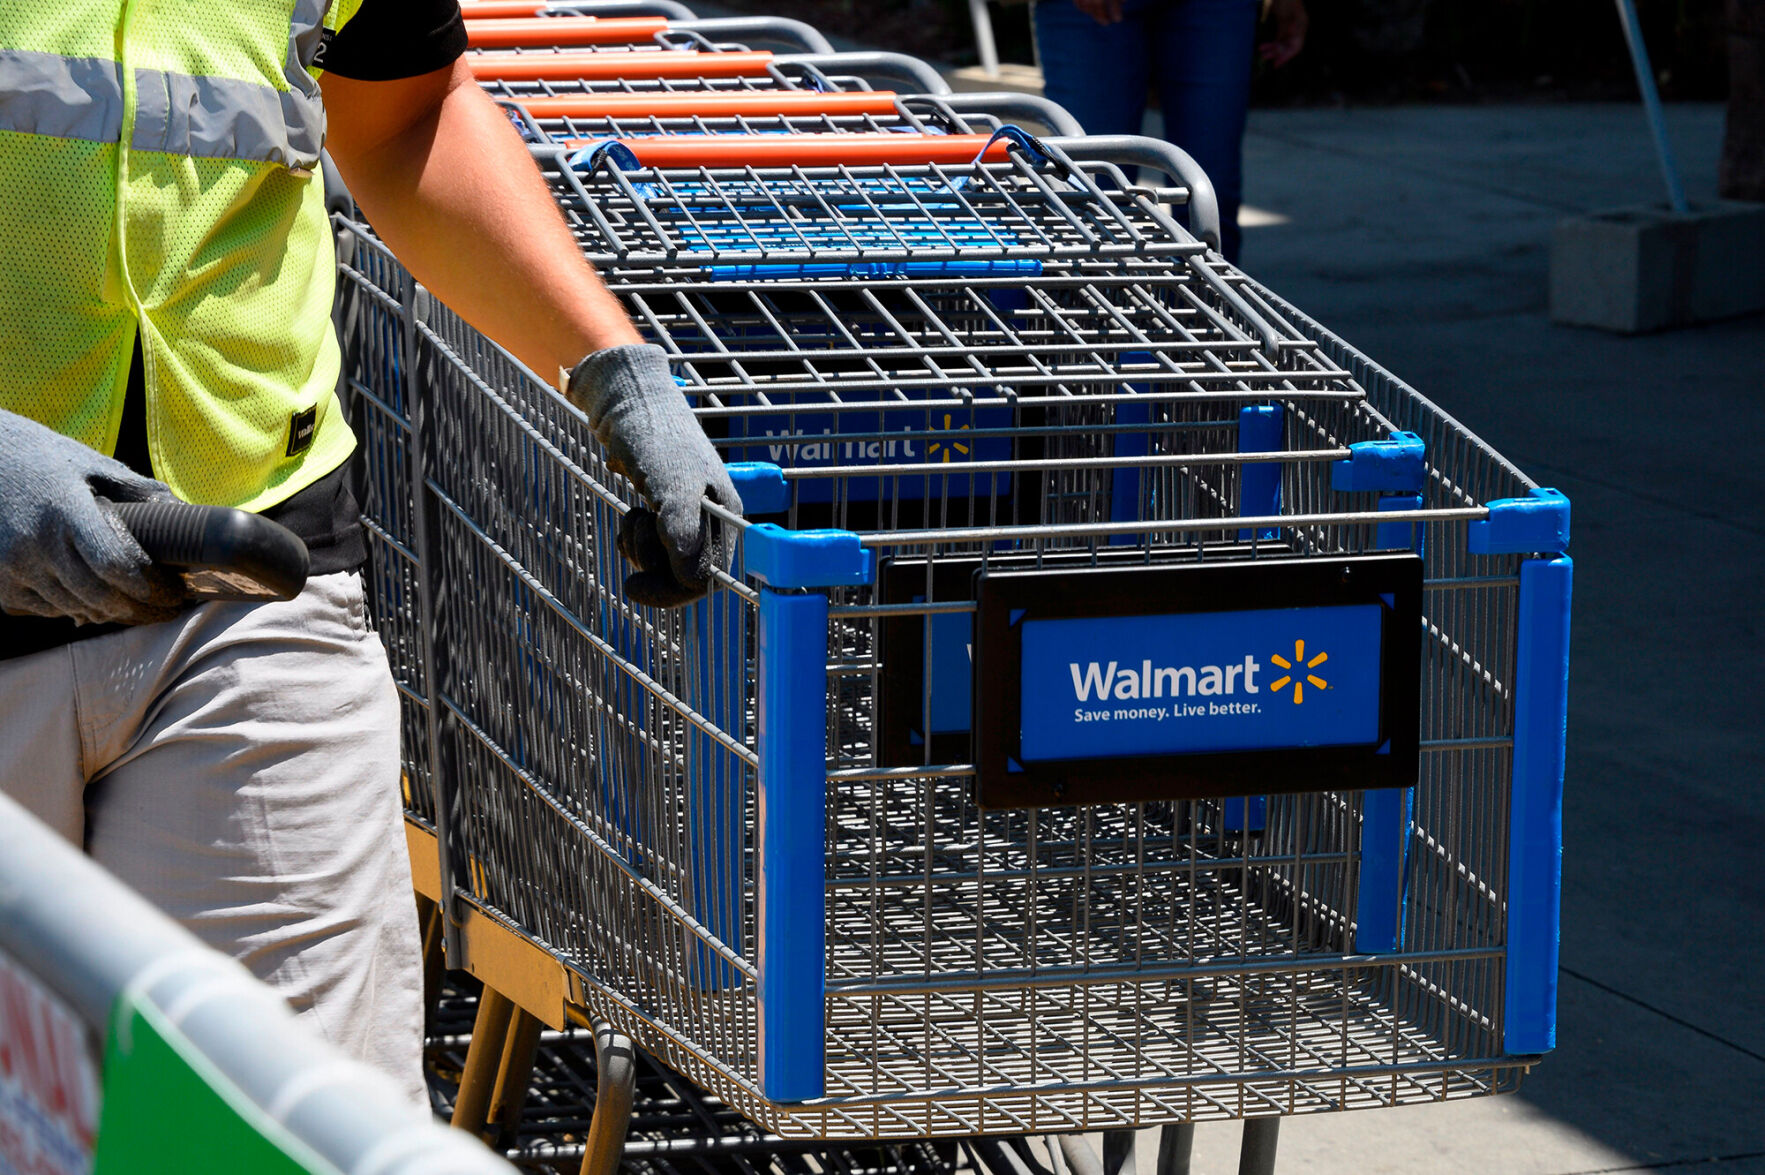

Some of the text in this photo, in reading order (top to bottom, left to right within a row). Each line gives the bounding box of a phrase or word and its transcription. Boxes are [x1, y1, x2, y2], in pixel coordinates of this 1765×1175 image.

[313, 41, 327, 63] 2
[1069, 655, 1260, 702] Walmart
[1074, 701, 1262, 722] Save money. Live better.
